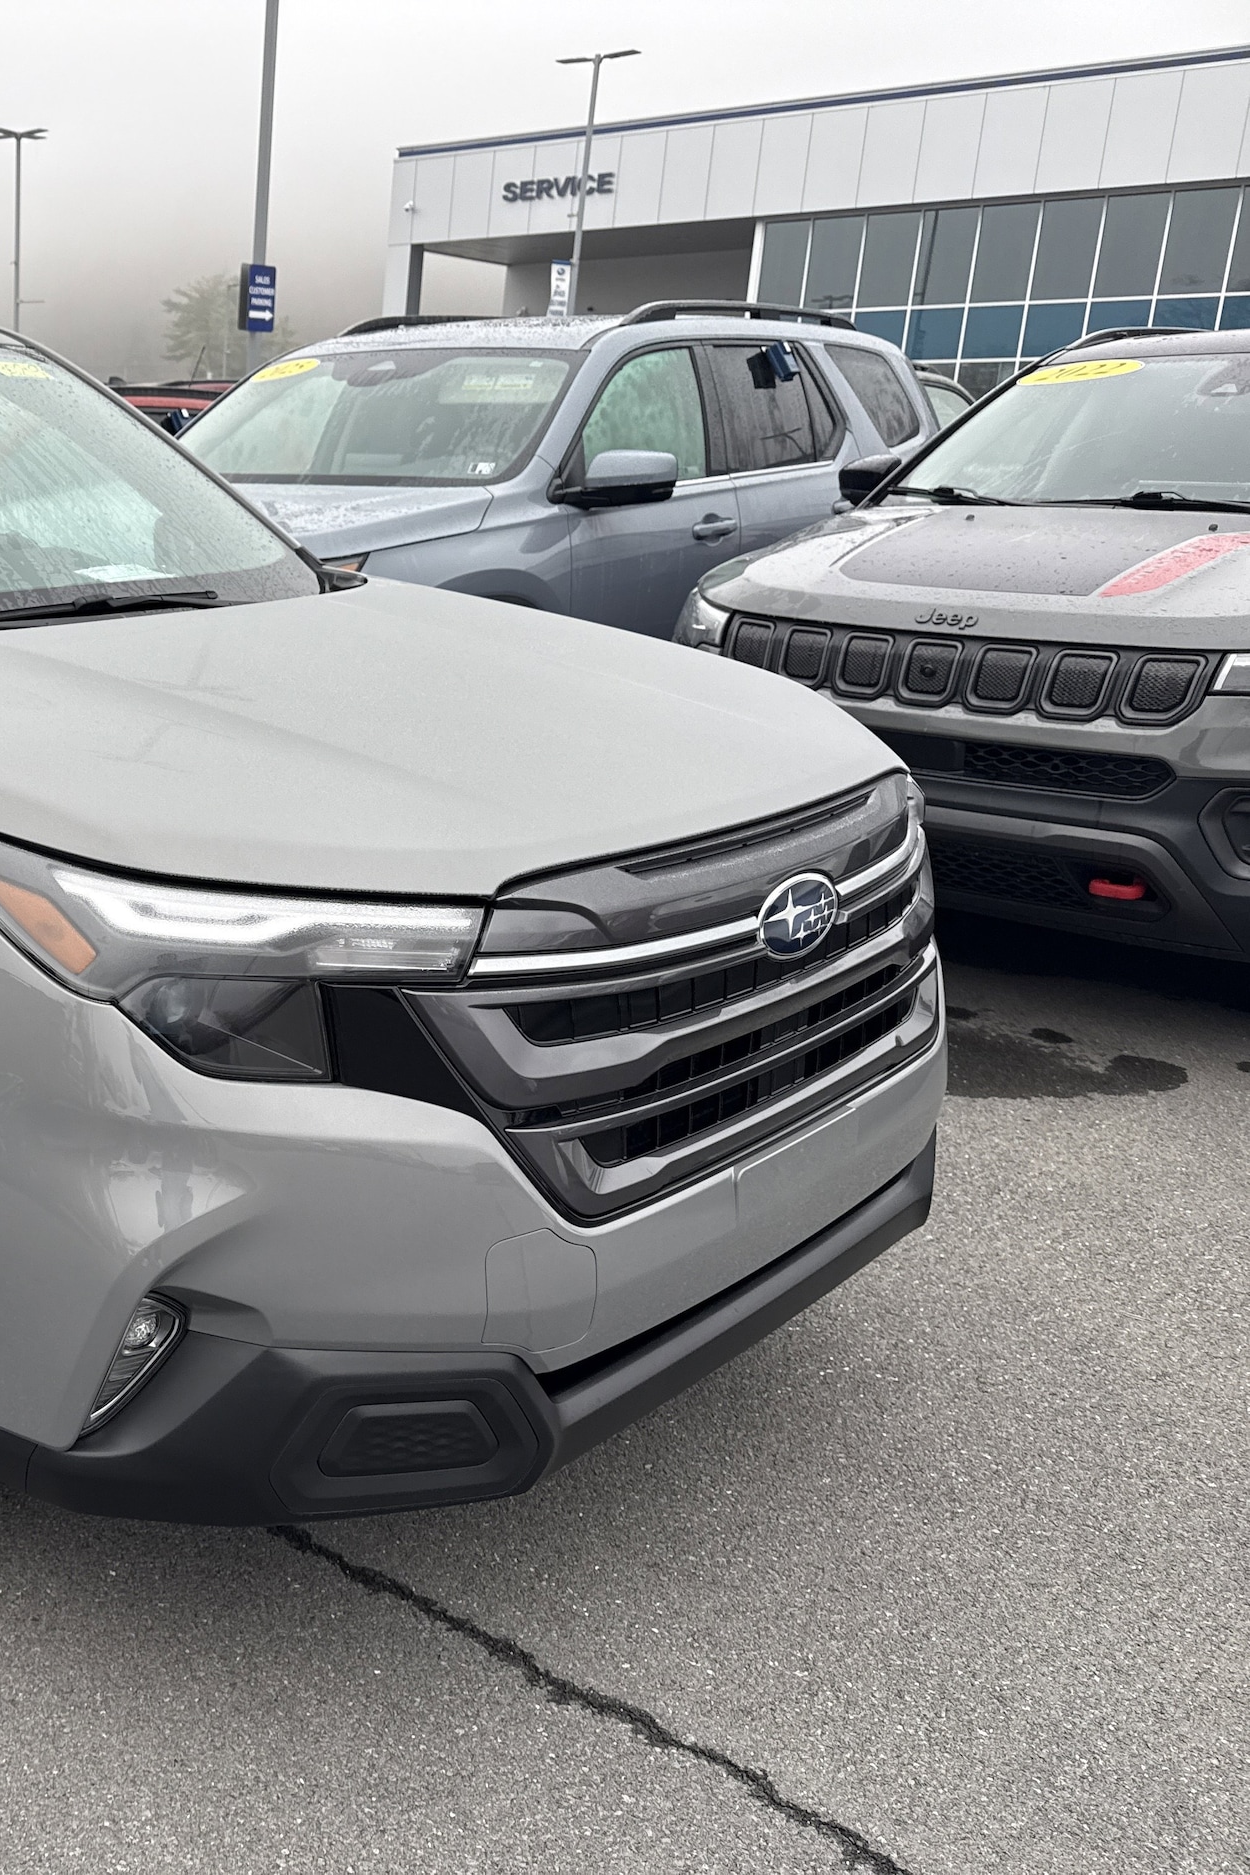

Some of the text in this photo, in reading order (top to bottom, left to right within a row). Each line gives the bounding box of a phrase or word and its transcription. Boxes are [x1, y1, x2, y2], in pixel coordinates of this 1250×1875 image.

[502, 172, 616, 202] SERVICE
[248, 285, 275, 296] CUSTOMER
[250, 296, 272, 307] PARKING
[1032, 362, 1128, 382] 2022
[914, 607, 979, 631] Jeep
